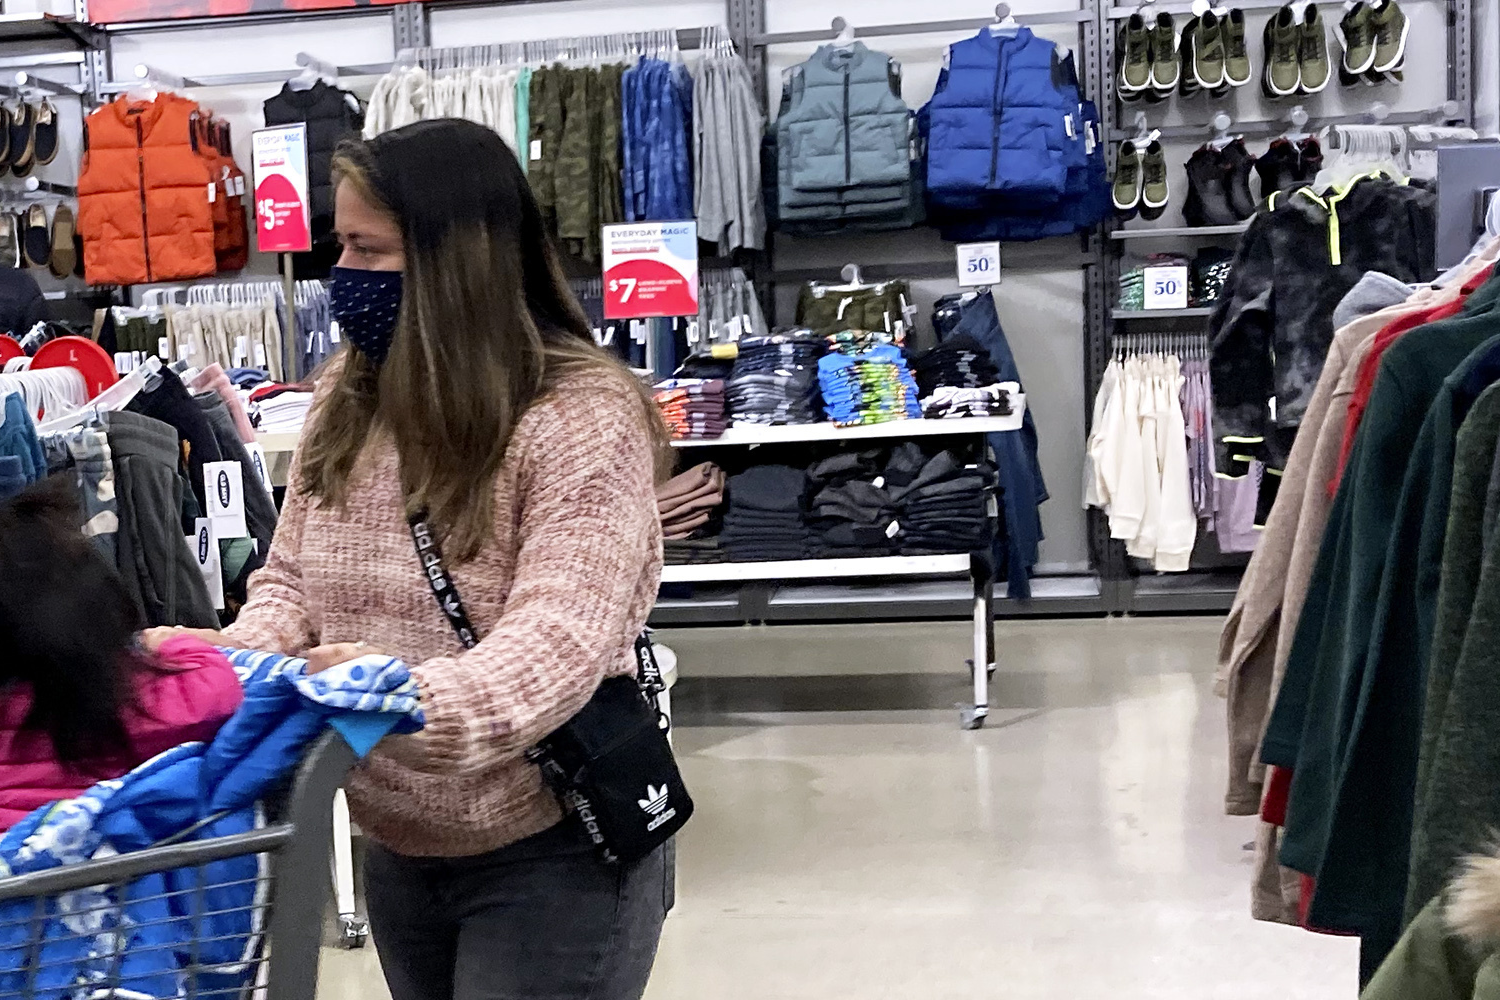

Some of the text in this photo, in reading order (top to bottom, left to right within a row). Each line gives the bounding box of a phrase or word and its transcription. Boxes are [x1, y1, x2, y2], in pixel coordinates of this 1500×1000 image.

[258, 198, 275, 230] $5
[611, 229, 657, 238] EVERYDAY
[967, 257, 989, 272] 50
[609, 278, 637, 303] $7
[1154, 280, 1176, 295] 50
[69, 349, 78, 361] L
[413, 522, 447, 591] addas
[647, 807, 676, 831] adidas
